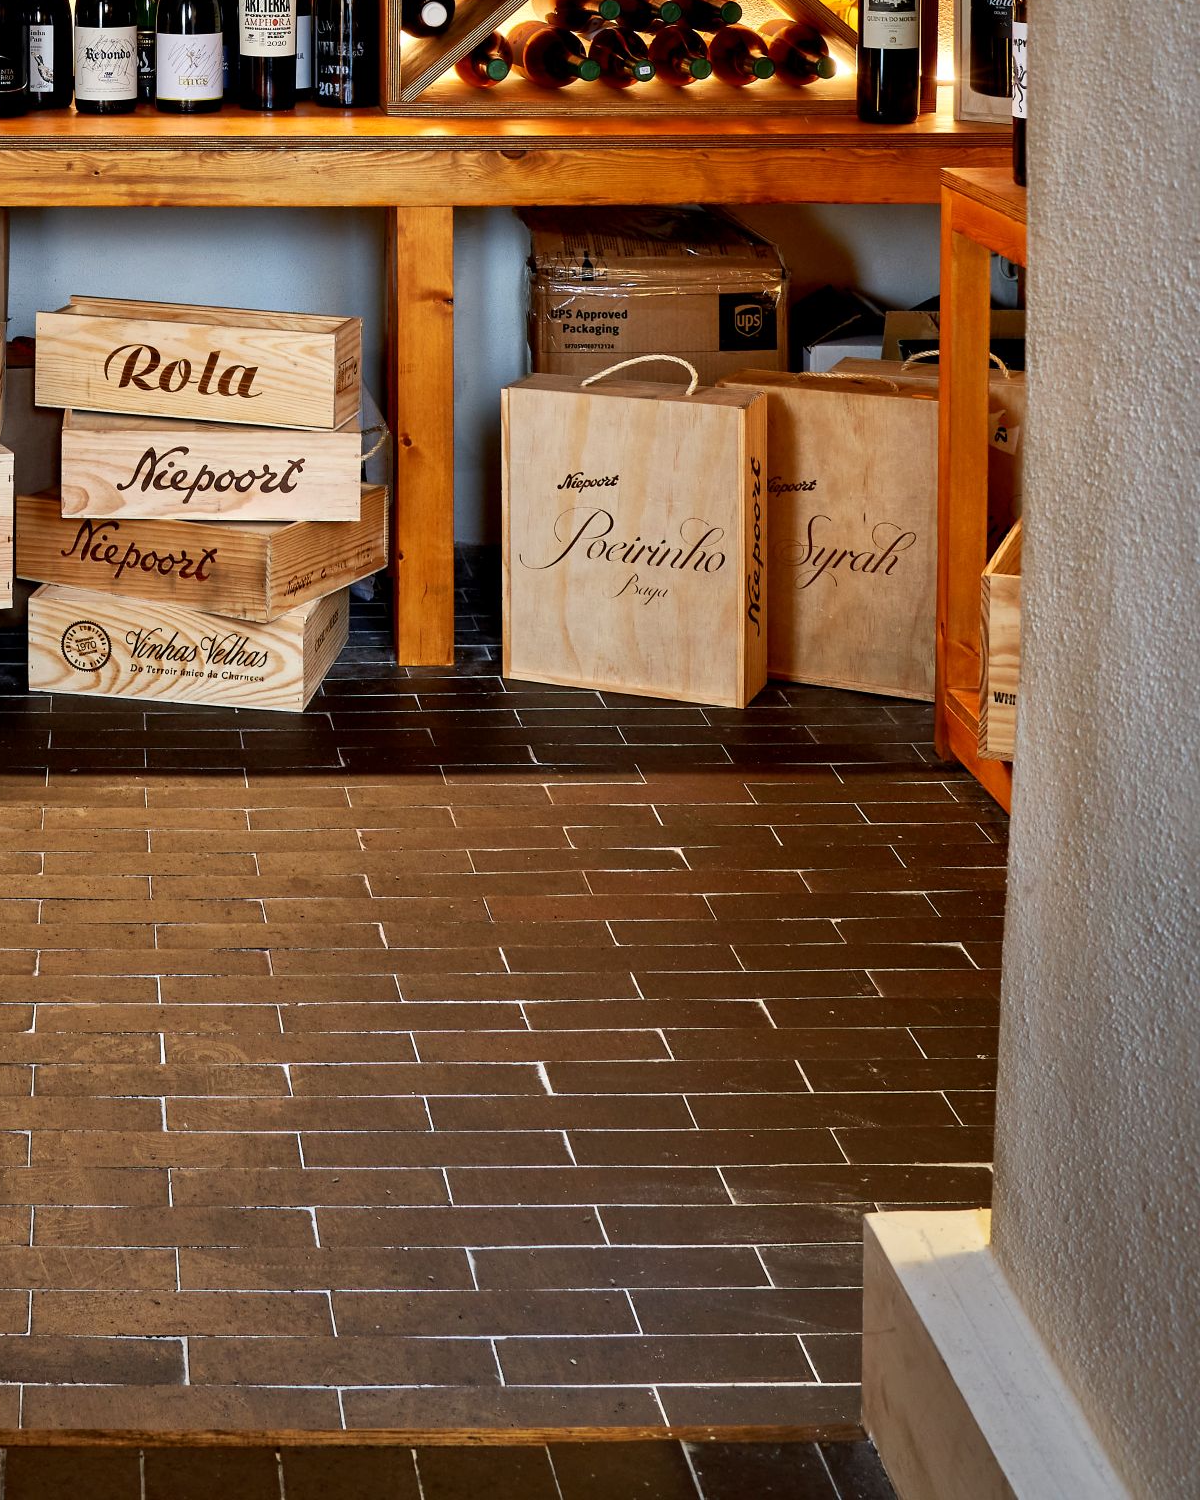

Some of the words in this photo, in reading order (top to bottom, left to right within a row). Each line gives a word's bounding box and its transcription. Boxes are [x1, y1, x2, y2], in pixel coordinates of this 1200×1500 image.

[244, 17, 291, 26] AMPHORA
[85, 47, 131, 62] Redondo
[575, 309, 628, 322] Approved
[736, 313, 762, 334] ups
[562, 323, 620, 336] Packaging
[104, 343, 263, 399] Rola
[117, 446, 306, 504] Niepoort
[557, 470, 619, 493] Niepoort
[61, 518, 218, 582] Niepoort
[519, 505, 727, 575] Poeirinho
[745, 456, 762, 637] Niepoort
[775, 514, 917, 589] Syrah
[615, 572, 668, 604] Baga
[76, 641, 97, 651] 1970
[125, 628, 199, 662] Vinhas
[200, 633, 269, 668] Velhas
[130, 664, 144, 673] Do
[146, 665, 177, 676] Terroir
[207, 670, 218, 679] da
[221, 671, 265, 682] Charneca
